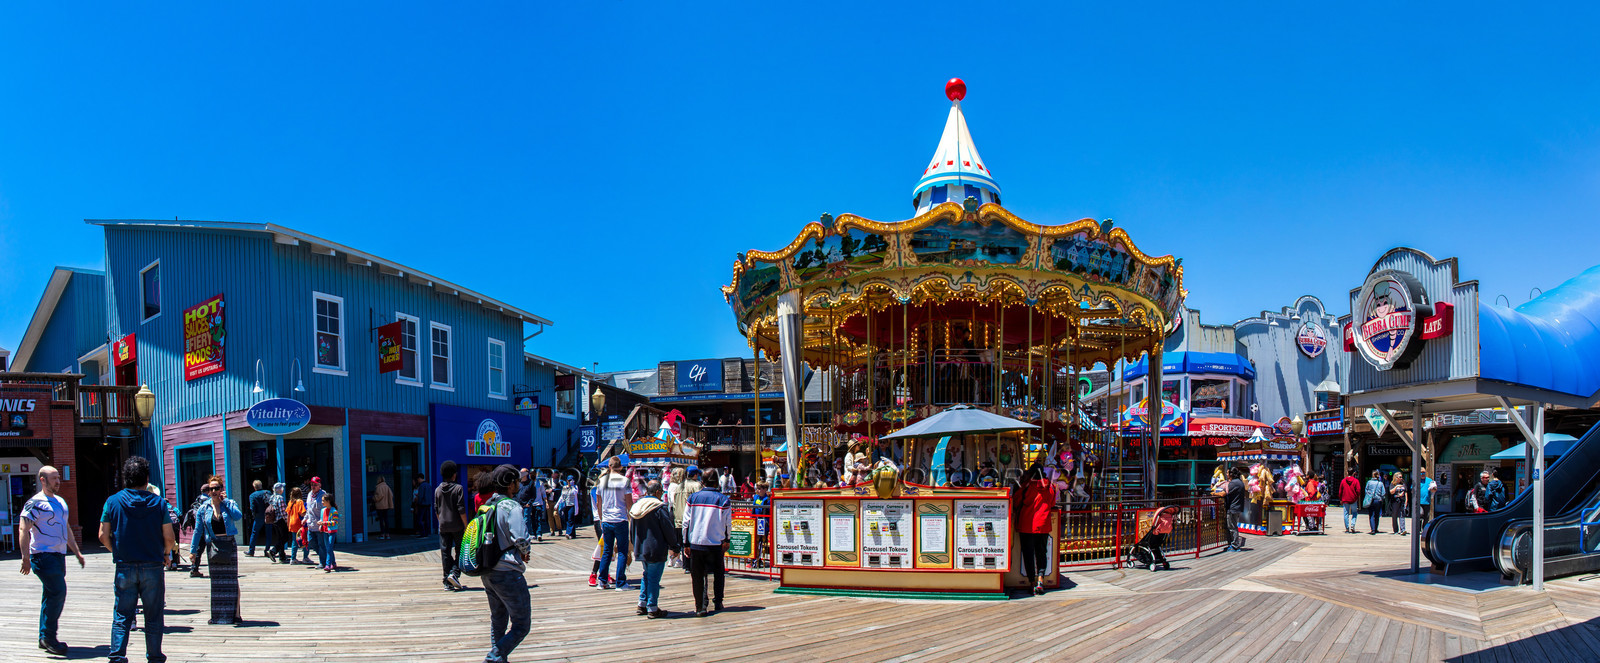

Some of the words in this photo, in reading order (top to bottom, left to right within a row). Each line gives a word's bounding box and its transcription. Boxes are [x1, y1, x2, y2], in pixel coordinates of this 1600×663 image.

[185, 298, 220, 325] HOT
[185, 317, 209, 339] SAUCES
[1362, 318, 1388, 338] BUBBA
[1388, 314, 1412, 328] GUMP
[1423, 317, 1442, 334] LATE
[189, 331, 212, 351] FIERY
[1345, 326, 1354, 341] OP
[186, 345, 212, 367] FOODS
[388, 344, 401, 355] HOT
[383, 353, 400, 364] LICKS
[251, 407, 294, 421] Vitality
[1311, 420, 1343, 432] ARCADE
[467, 440, 511, 456] WORKSHOP
[581, 435, 595, 448] 39
[1269, 441, 1297, 449] CHURROS
[800, 543, 819, 551] Tokens
